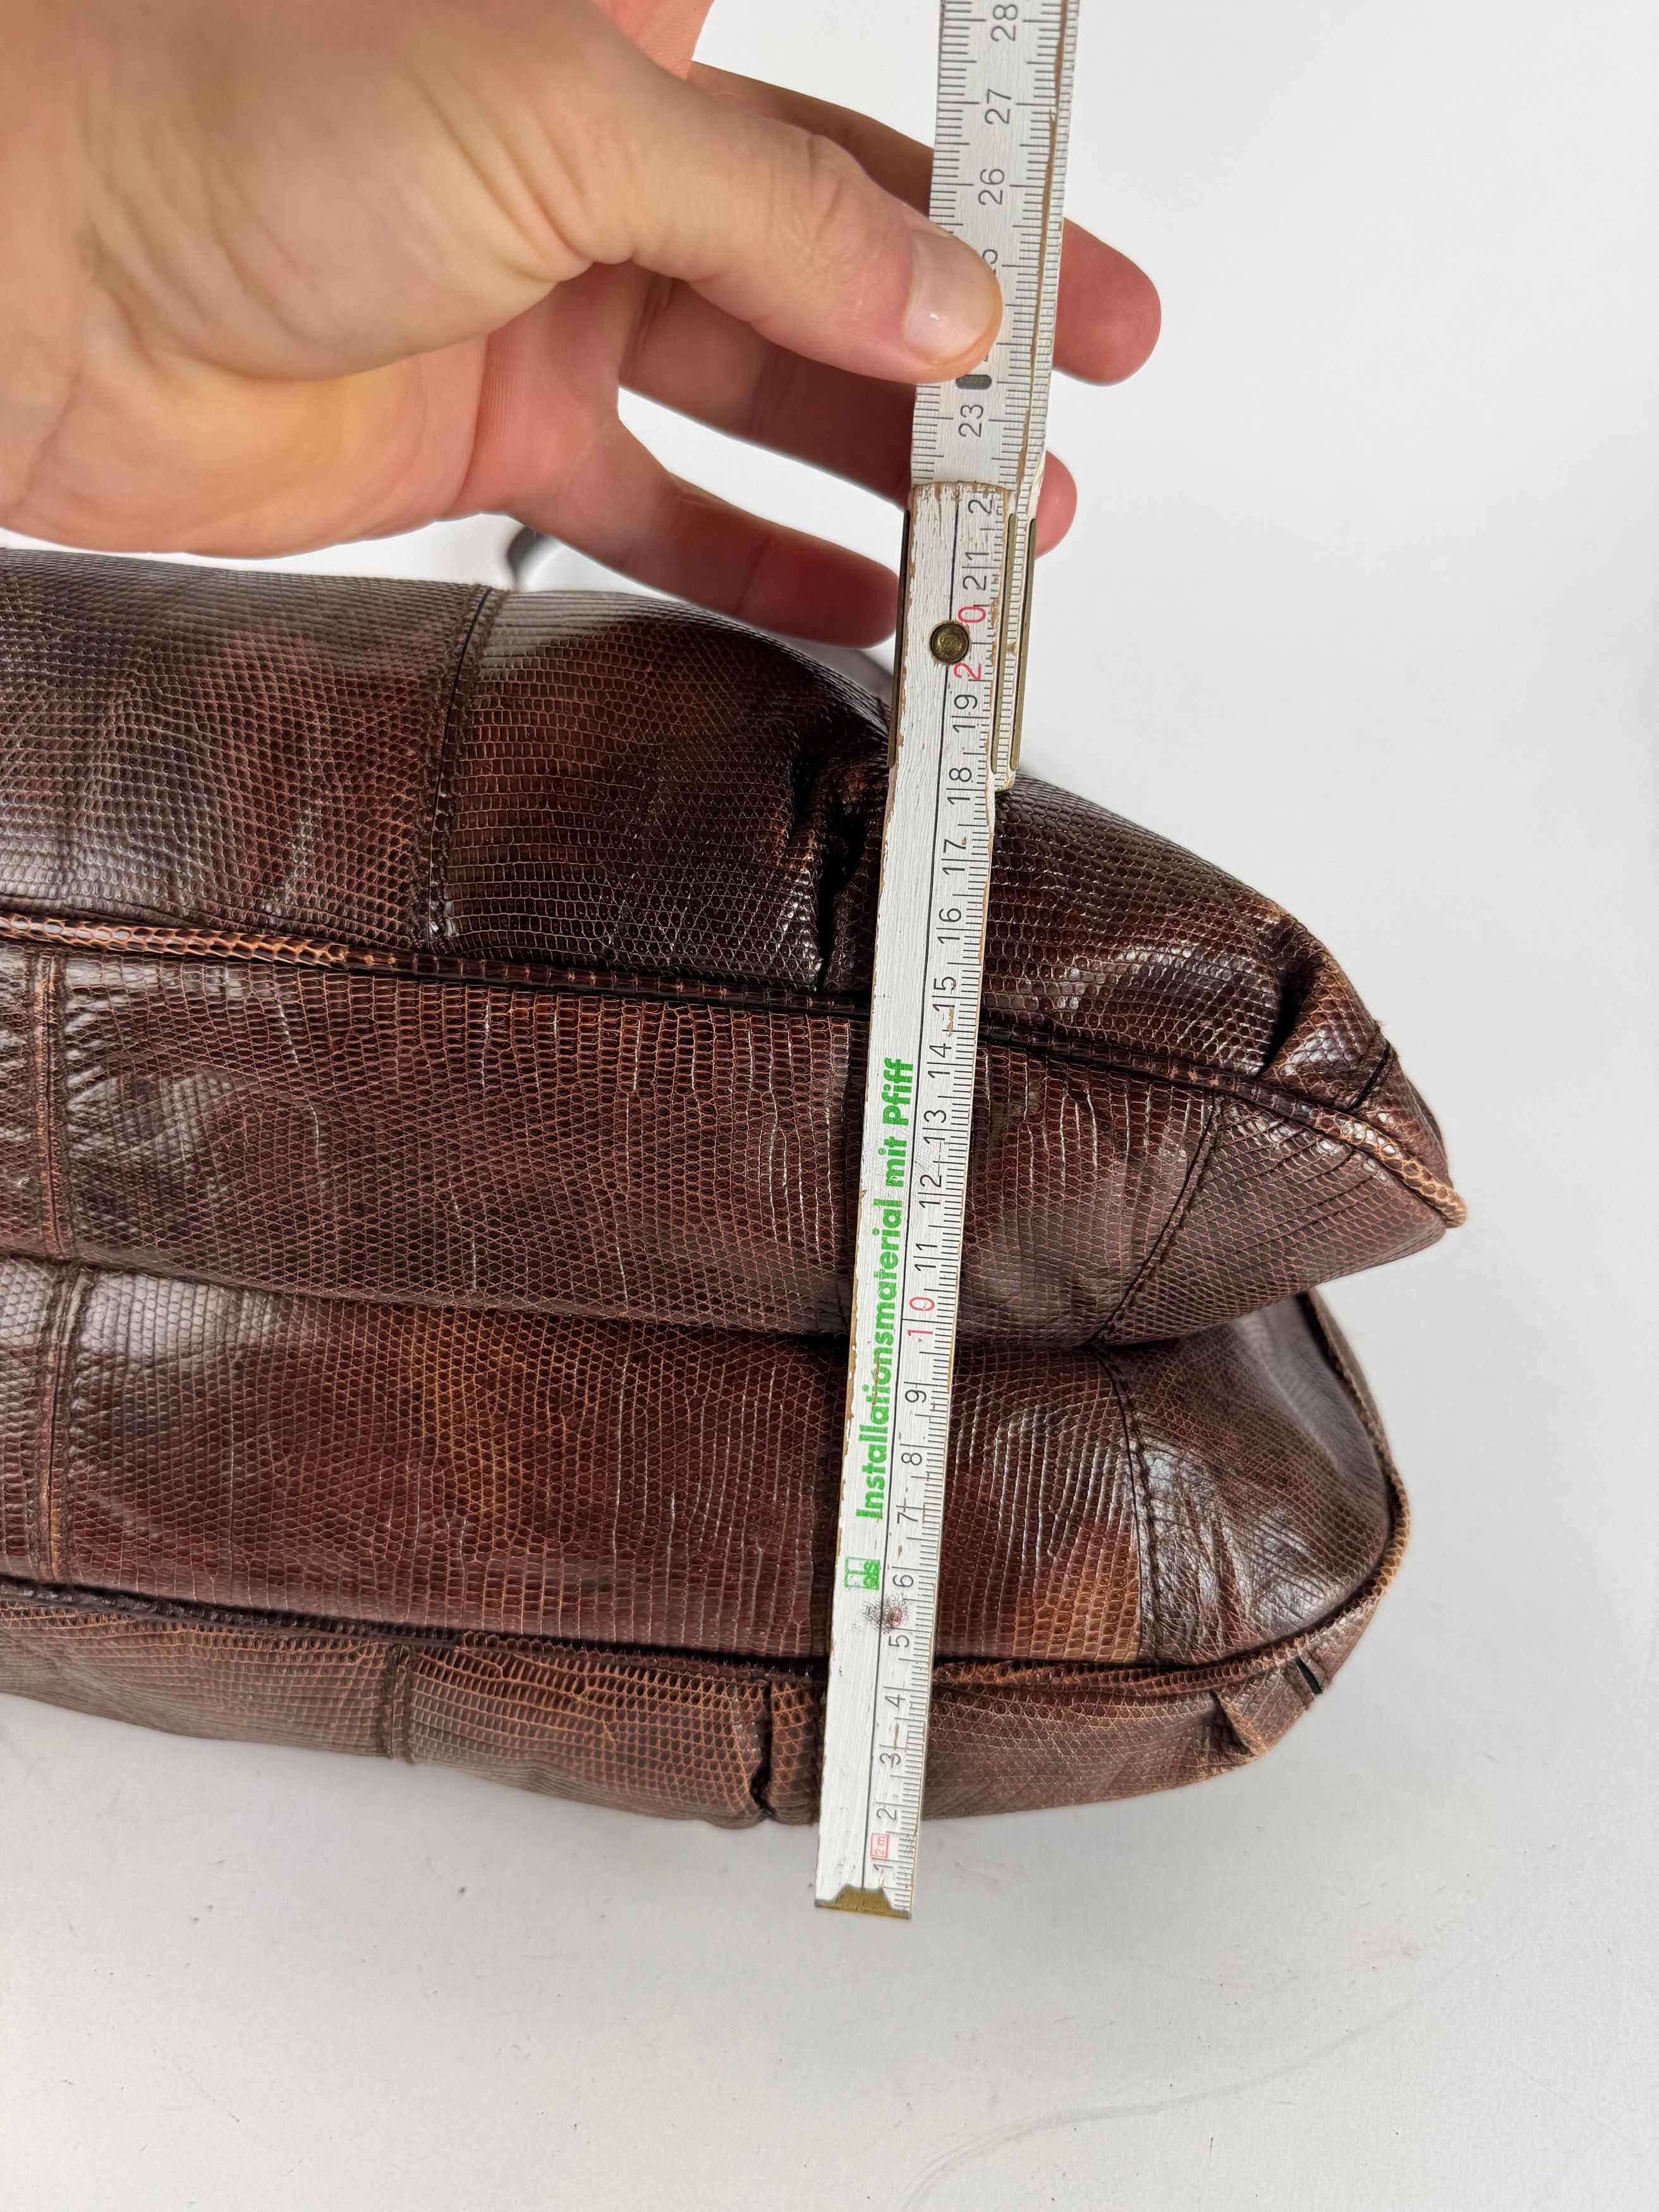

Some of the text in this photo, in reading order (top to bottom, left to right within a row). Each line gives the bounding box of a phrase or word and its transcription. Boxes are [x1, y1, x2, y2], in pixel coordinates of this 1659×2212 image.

[990, 4, 1019, 42] 28
[984, 88, 1012, 125] 27
[978, 168, 1005, 205] 26
[959, 404, 984, 438] 23
[963, 551, 990, 591] 21
[953, 606, 987, 681] 20
[952, 694, 978, 733] 19
[947, 767, 973, 806] 18
[942, 839, 967, 875] 17
[937, 908, 962, 944] 16
[933, 976, 956, 1012] 15
[928, 1043, 952, 1079] 14
[923, 1110, 946, 1145] 13
[919, 1174, 942, 1208] 12
[915, 1243, 938, 1272] 11
[856, 1057, 914, 1519] Installationsmaterial mit Pfiff
[907, 1297, 935, 1338] 10
[904, 1389, 927, 1403] 9
[901, 1452, 922, 1466] 8
[896, 1512, 918, 1524] 7
[892, 1574, 914, 1588] 6
[889, 1634, 910, 1648] 5
[884, 1694, 905, 1708] 4
[880, 1753, 901, 1766] 3
[877, 1808, 897, 1820] 2
[877, 1835, 886, 1845] m
